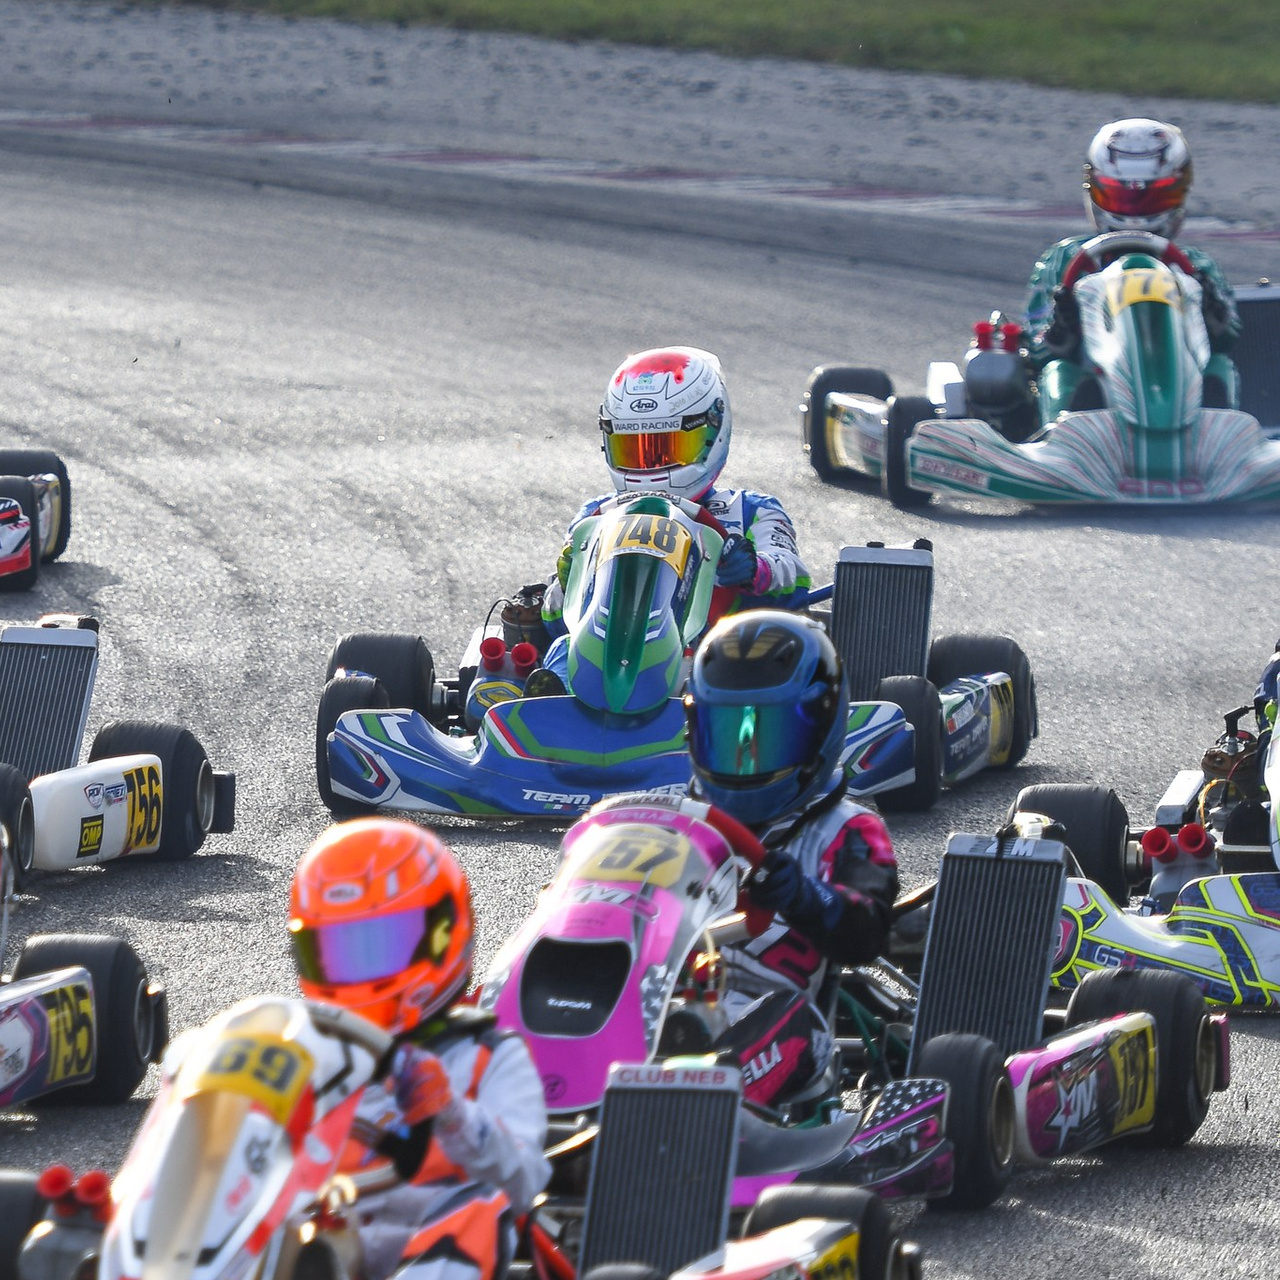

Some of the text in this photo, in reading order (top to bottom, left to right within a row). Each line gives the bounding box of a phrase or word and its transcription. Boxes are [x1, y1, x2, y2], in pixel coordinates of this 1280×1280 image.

[614, 422, 639, 431] WARD
[641, 421, 680, 430] RACING
[614, 516, 680, 554] 748
[522, 788, 591, 805] TEAM
[123, 766, 160, 848] 756
[82, 826, 102, 846] OMP
[40, 983, 94, 1081] 795
[620, 1070, 727, 1085] CLUB NEB
